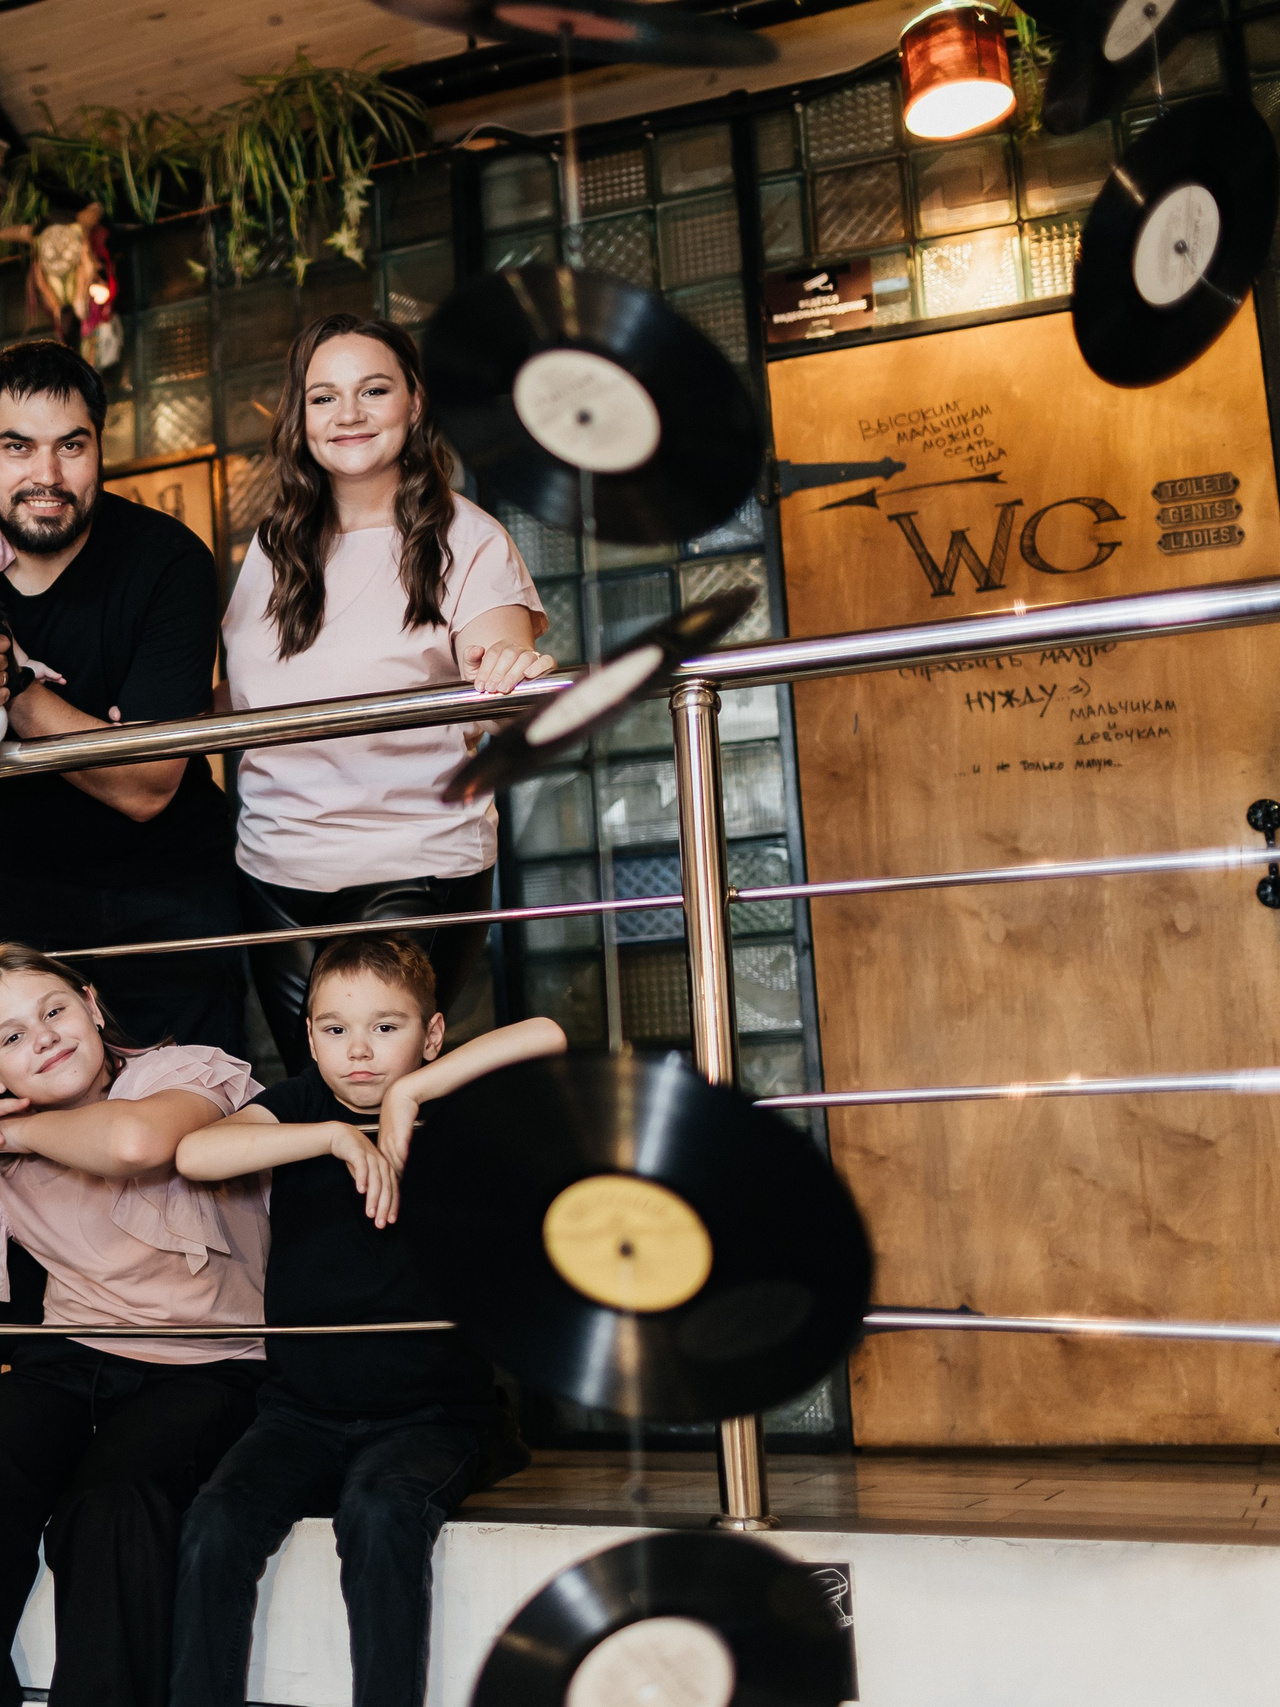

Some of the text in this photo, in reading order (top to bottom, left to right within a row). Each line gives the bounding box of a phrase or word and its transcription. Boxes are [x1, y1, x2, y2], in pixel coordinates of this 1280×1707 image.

[922, 423, 984, 453] МОЖНО
[1165, 475, 1225, 498] TOILET
[1168, 501, 1227, 523] GENTS
[1170, 527, 1230, 550] LADIES
[1069, 699, 1178, 722] МАЛЬЧИКАМ
